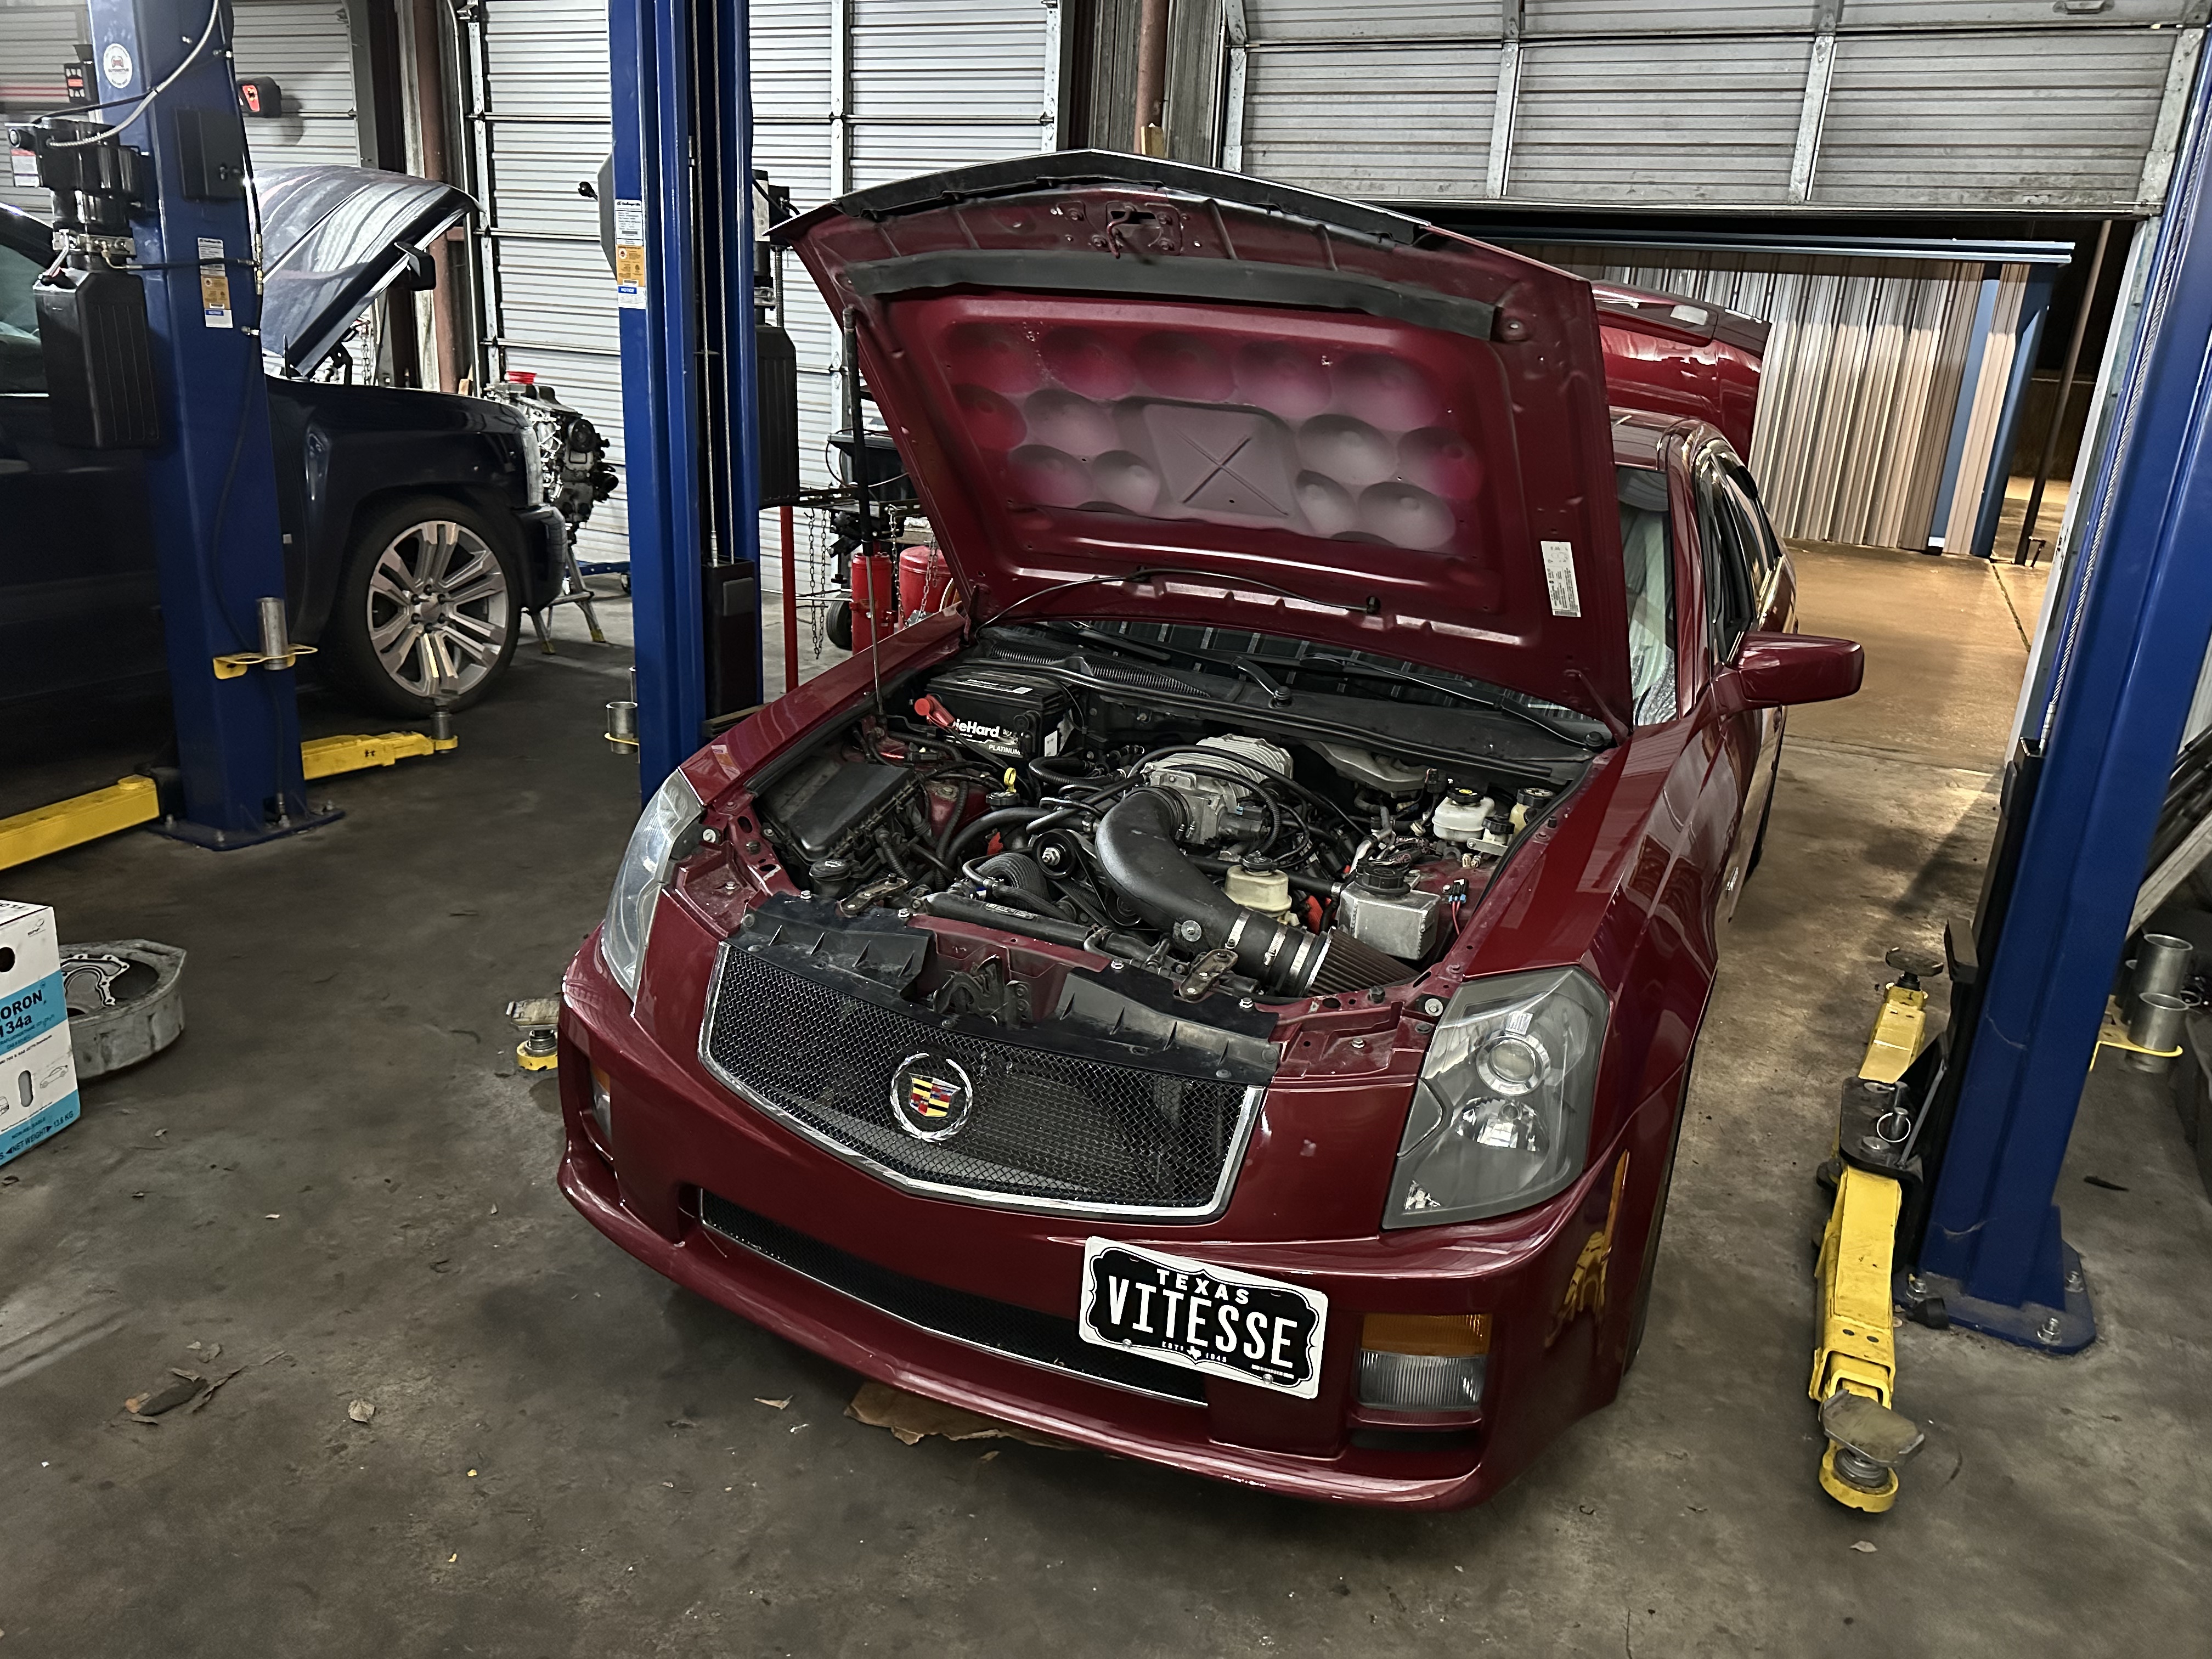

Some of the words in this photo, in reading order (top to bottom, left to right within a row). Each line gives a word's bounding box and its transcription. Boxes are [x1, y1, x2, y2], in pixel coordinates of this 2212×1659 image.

[988, 744, 1020, 755] PLATINUM
[0, 989, 43, 1020] ORON
[12, 1141, 24, 1152] NET
[25, 1126, 47, 1144] WEIGHT
[65, 1110, 74, 1121] KG
[1156, 1268, 1250, 1305] TEXAS
[1108, 1275, 1298, 1369] VITESSE
